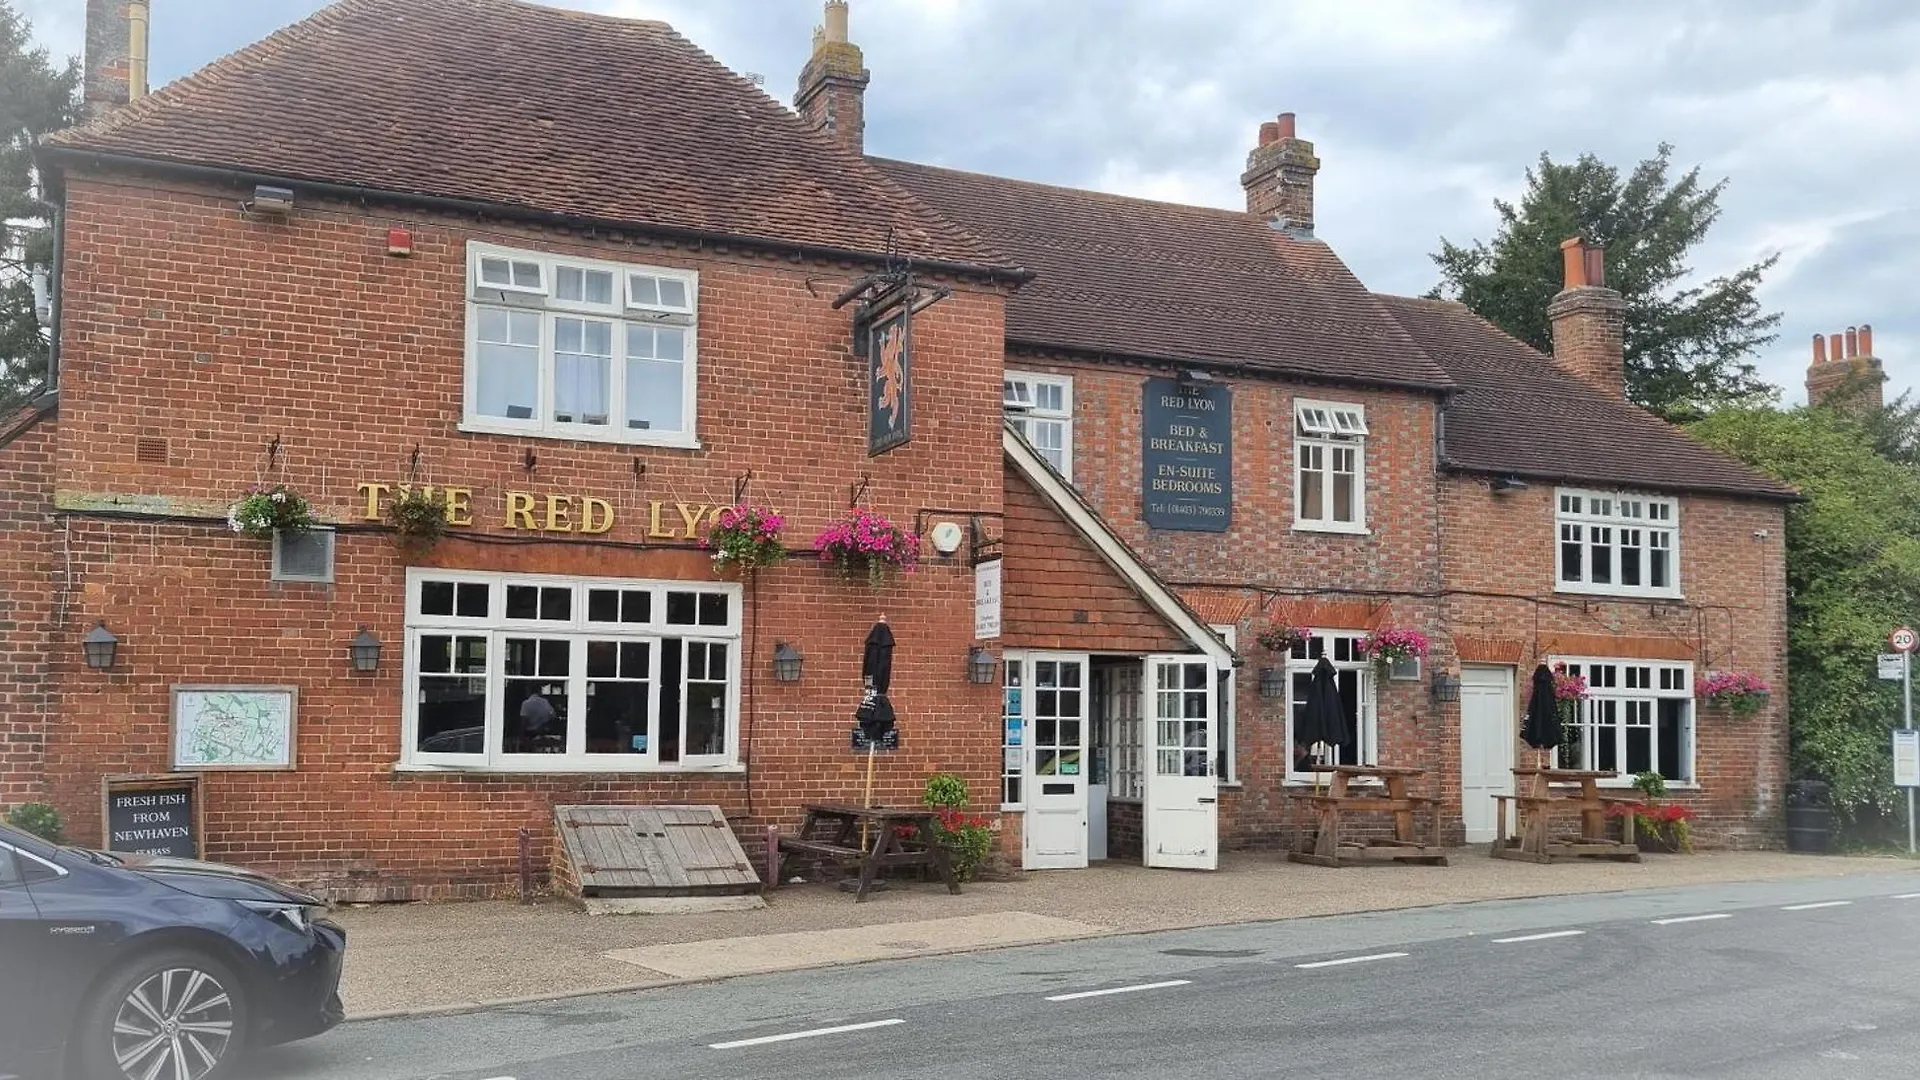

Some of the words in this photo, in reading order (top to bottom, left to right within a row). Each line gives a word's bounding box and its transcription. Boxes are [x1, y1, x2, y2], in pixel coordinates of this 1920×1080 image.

[1161, 396, 1185, 408] RED
[1188, 398, 1216, 411] LYON
[1169, 425, 1195, 437] BED
[1199, 427, 1209, 439] &
[1151, 438, 1224, 455] BREAKFAST
[1159, 464, 1216, 479] EN-SUITE
[1152, 480, 1222, 494] BEDROOMS
[503, 491, 615, 533] RED
[1895, 634, 1912, 644] 20
[116, 796, 156, 808] FRESH
[160, 794, 186, 805] FISH
[133, 812, 170, 823] FROM
[114, 827, 189, 841] NEWHAVEN
